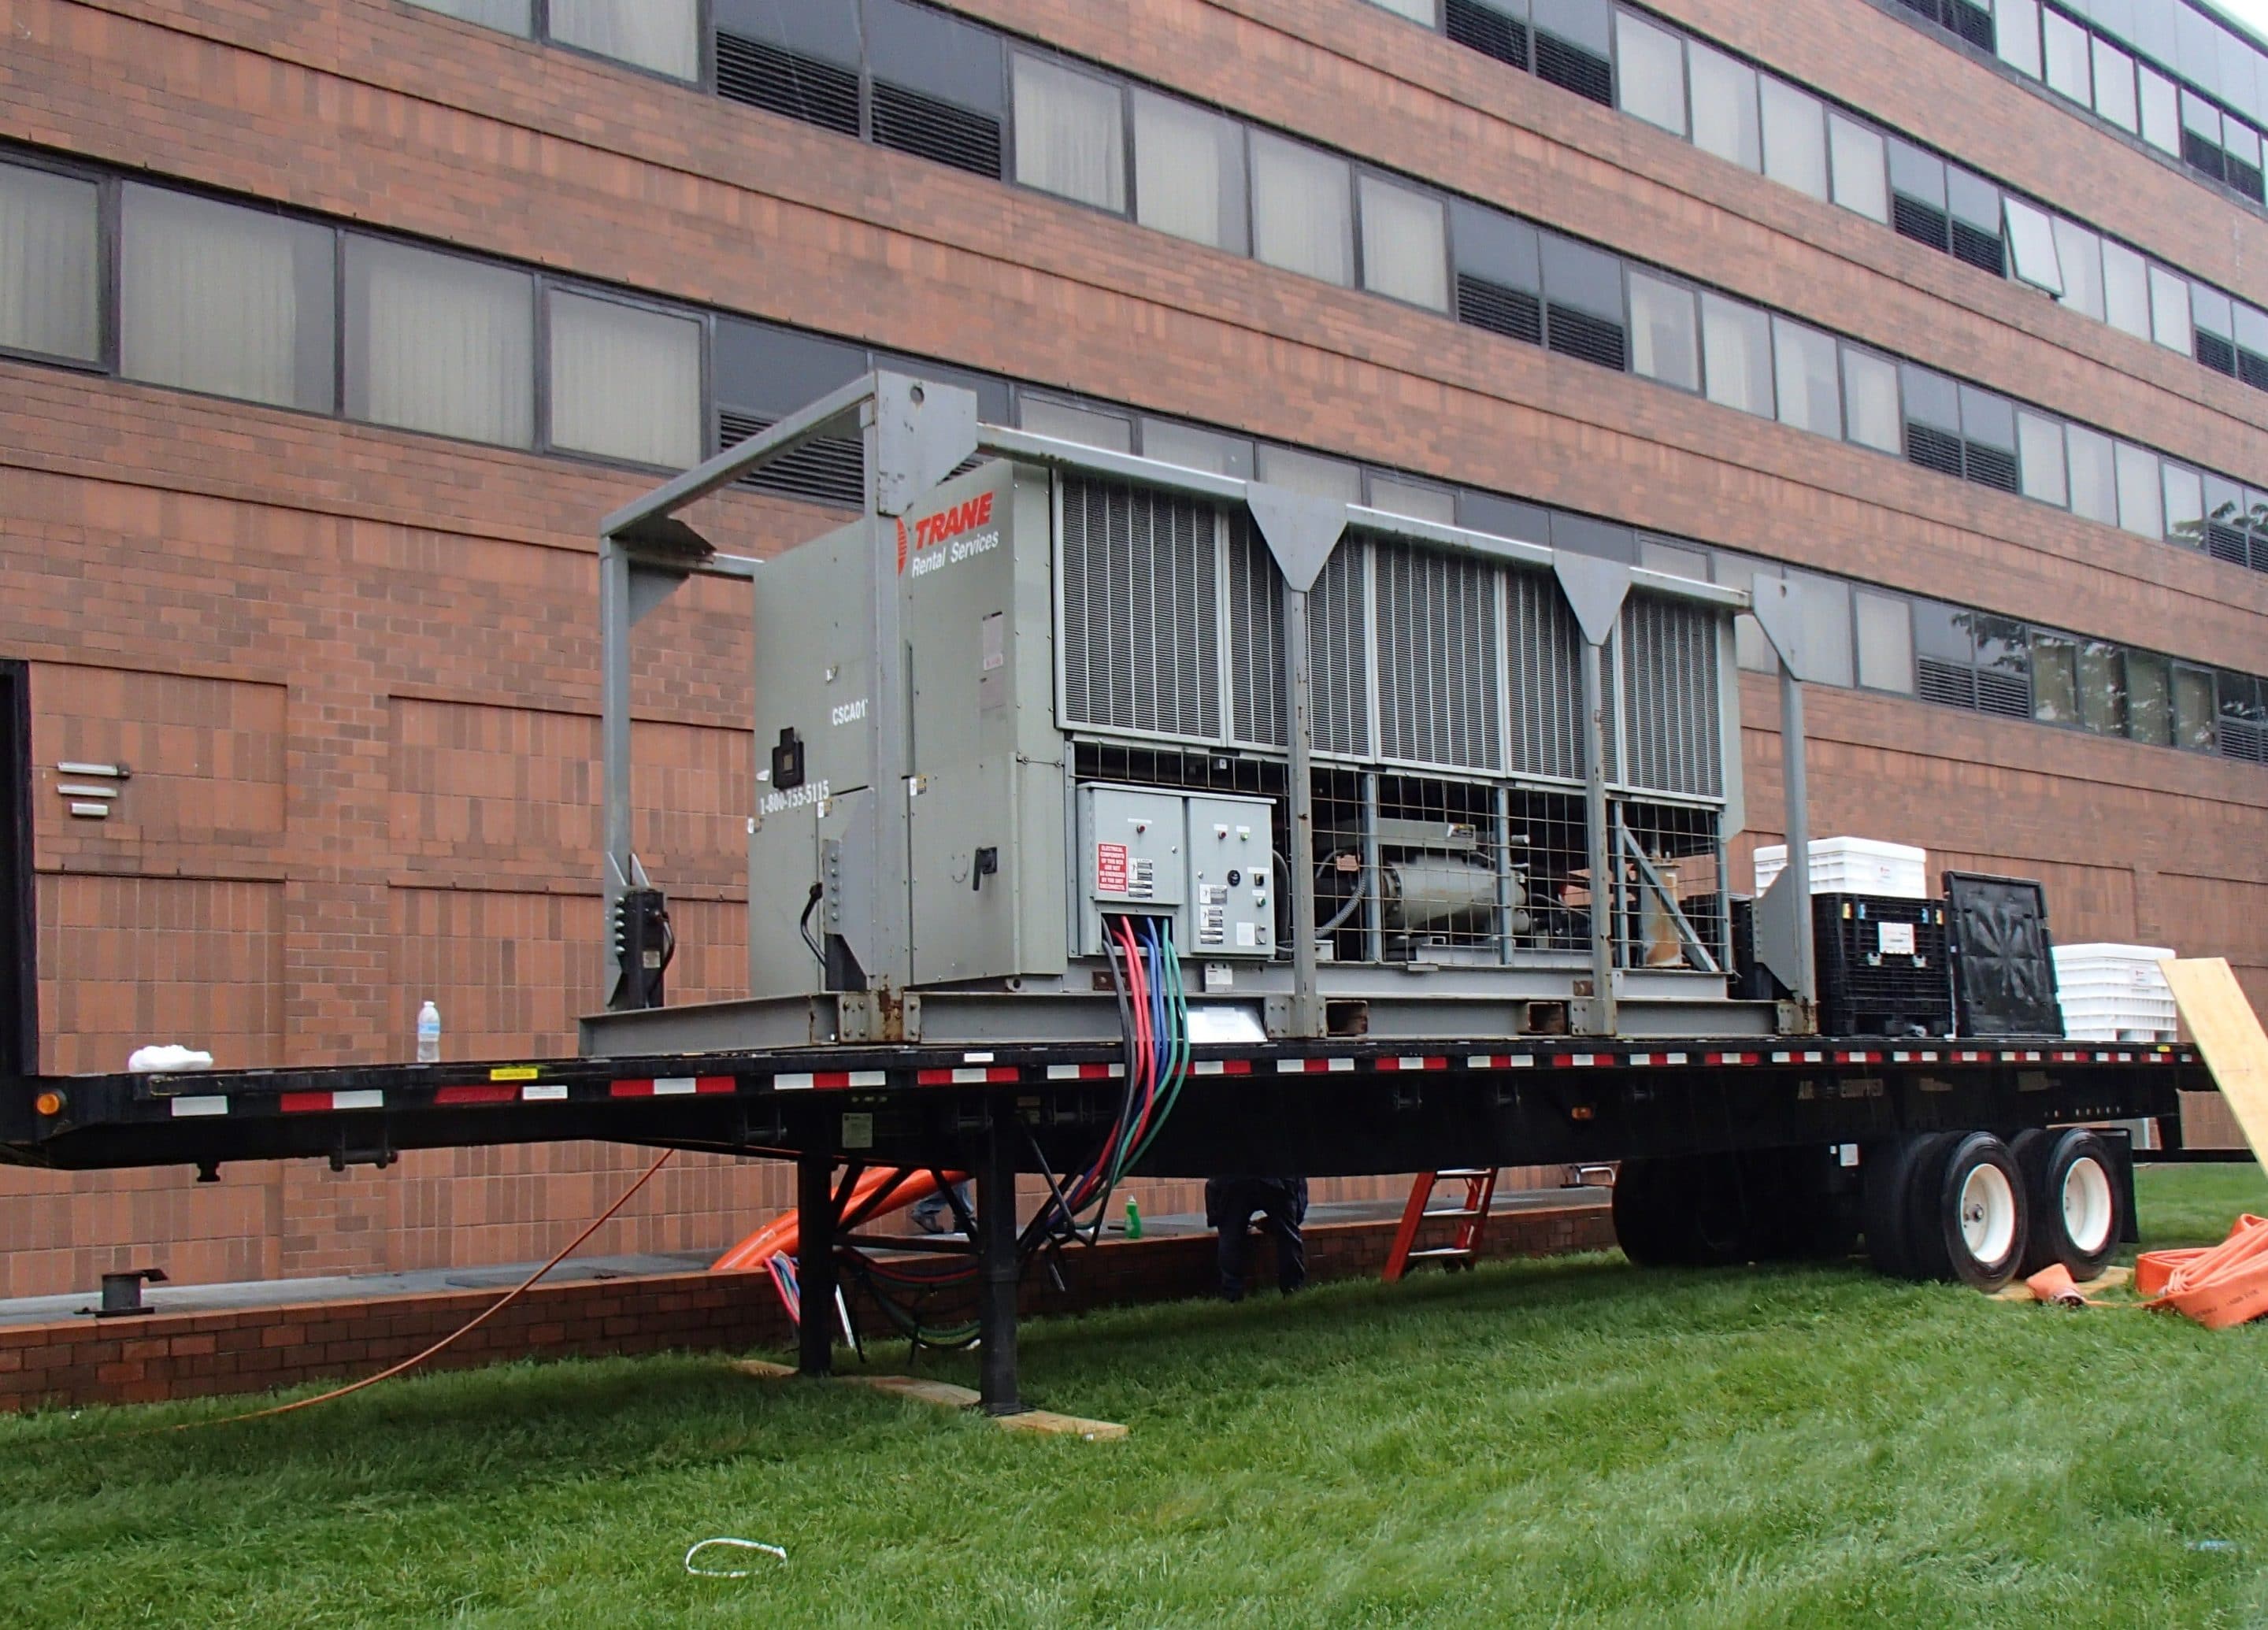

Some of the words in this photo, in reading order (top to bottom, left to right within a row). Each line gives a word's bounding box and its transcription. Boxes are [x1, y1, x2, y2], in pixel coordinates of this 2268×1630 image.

[915, 491, 993, 550] TRANE
[912, 546, 947, 578] Rental
[951, 531, 999, 563] Services
[760, 780, 829, 815] 1-800-755-5115
